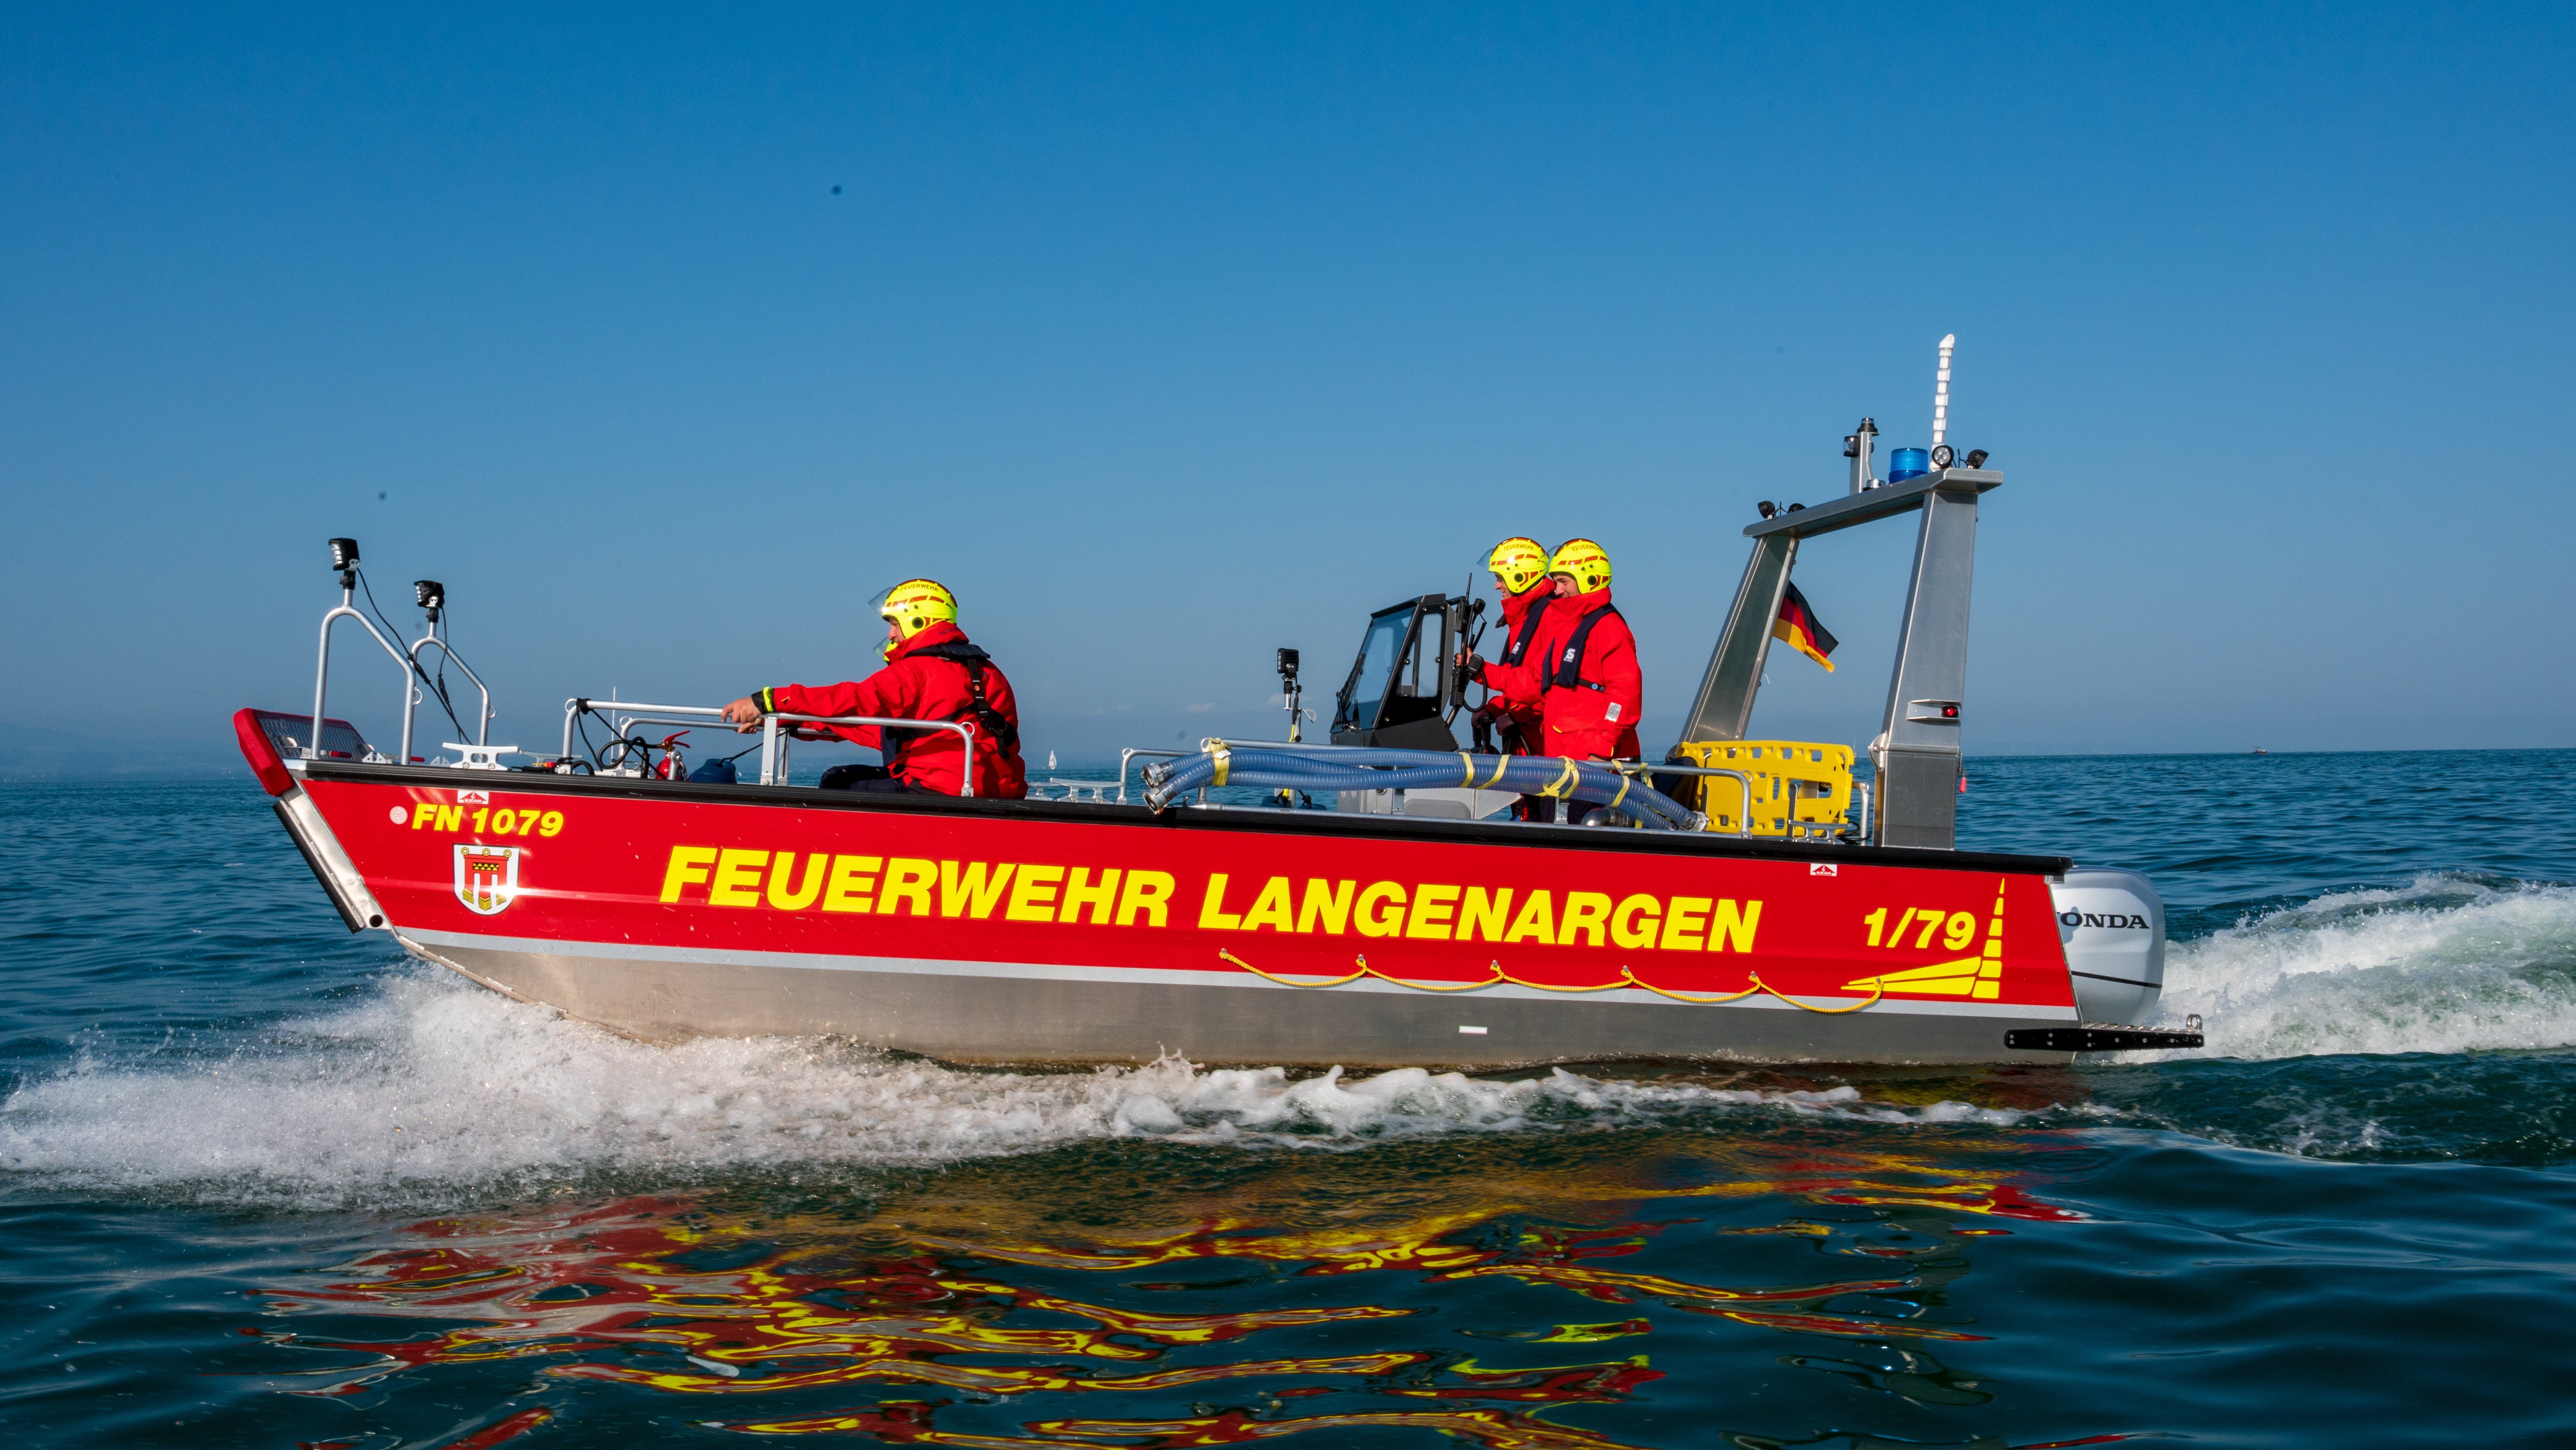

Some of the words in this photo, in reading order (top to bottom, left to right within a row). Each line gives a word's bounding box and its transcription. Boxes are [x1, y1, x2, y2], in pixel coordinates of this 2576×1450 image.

[900, 583, 939, 592] FEUERWEHR
[412, 802, 464, 832] FN
[472, 808, 564, 837] 1079
[659, 846, 1175, 927] FEUERWEHR
[1198, 873, 1763, 953] LANGENARGEN
[1864, 907, 1976, 950] 1/79
[2057, 912, 2150, 929] ONDA
